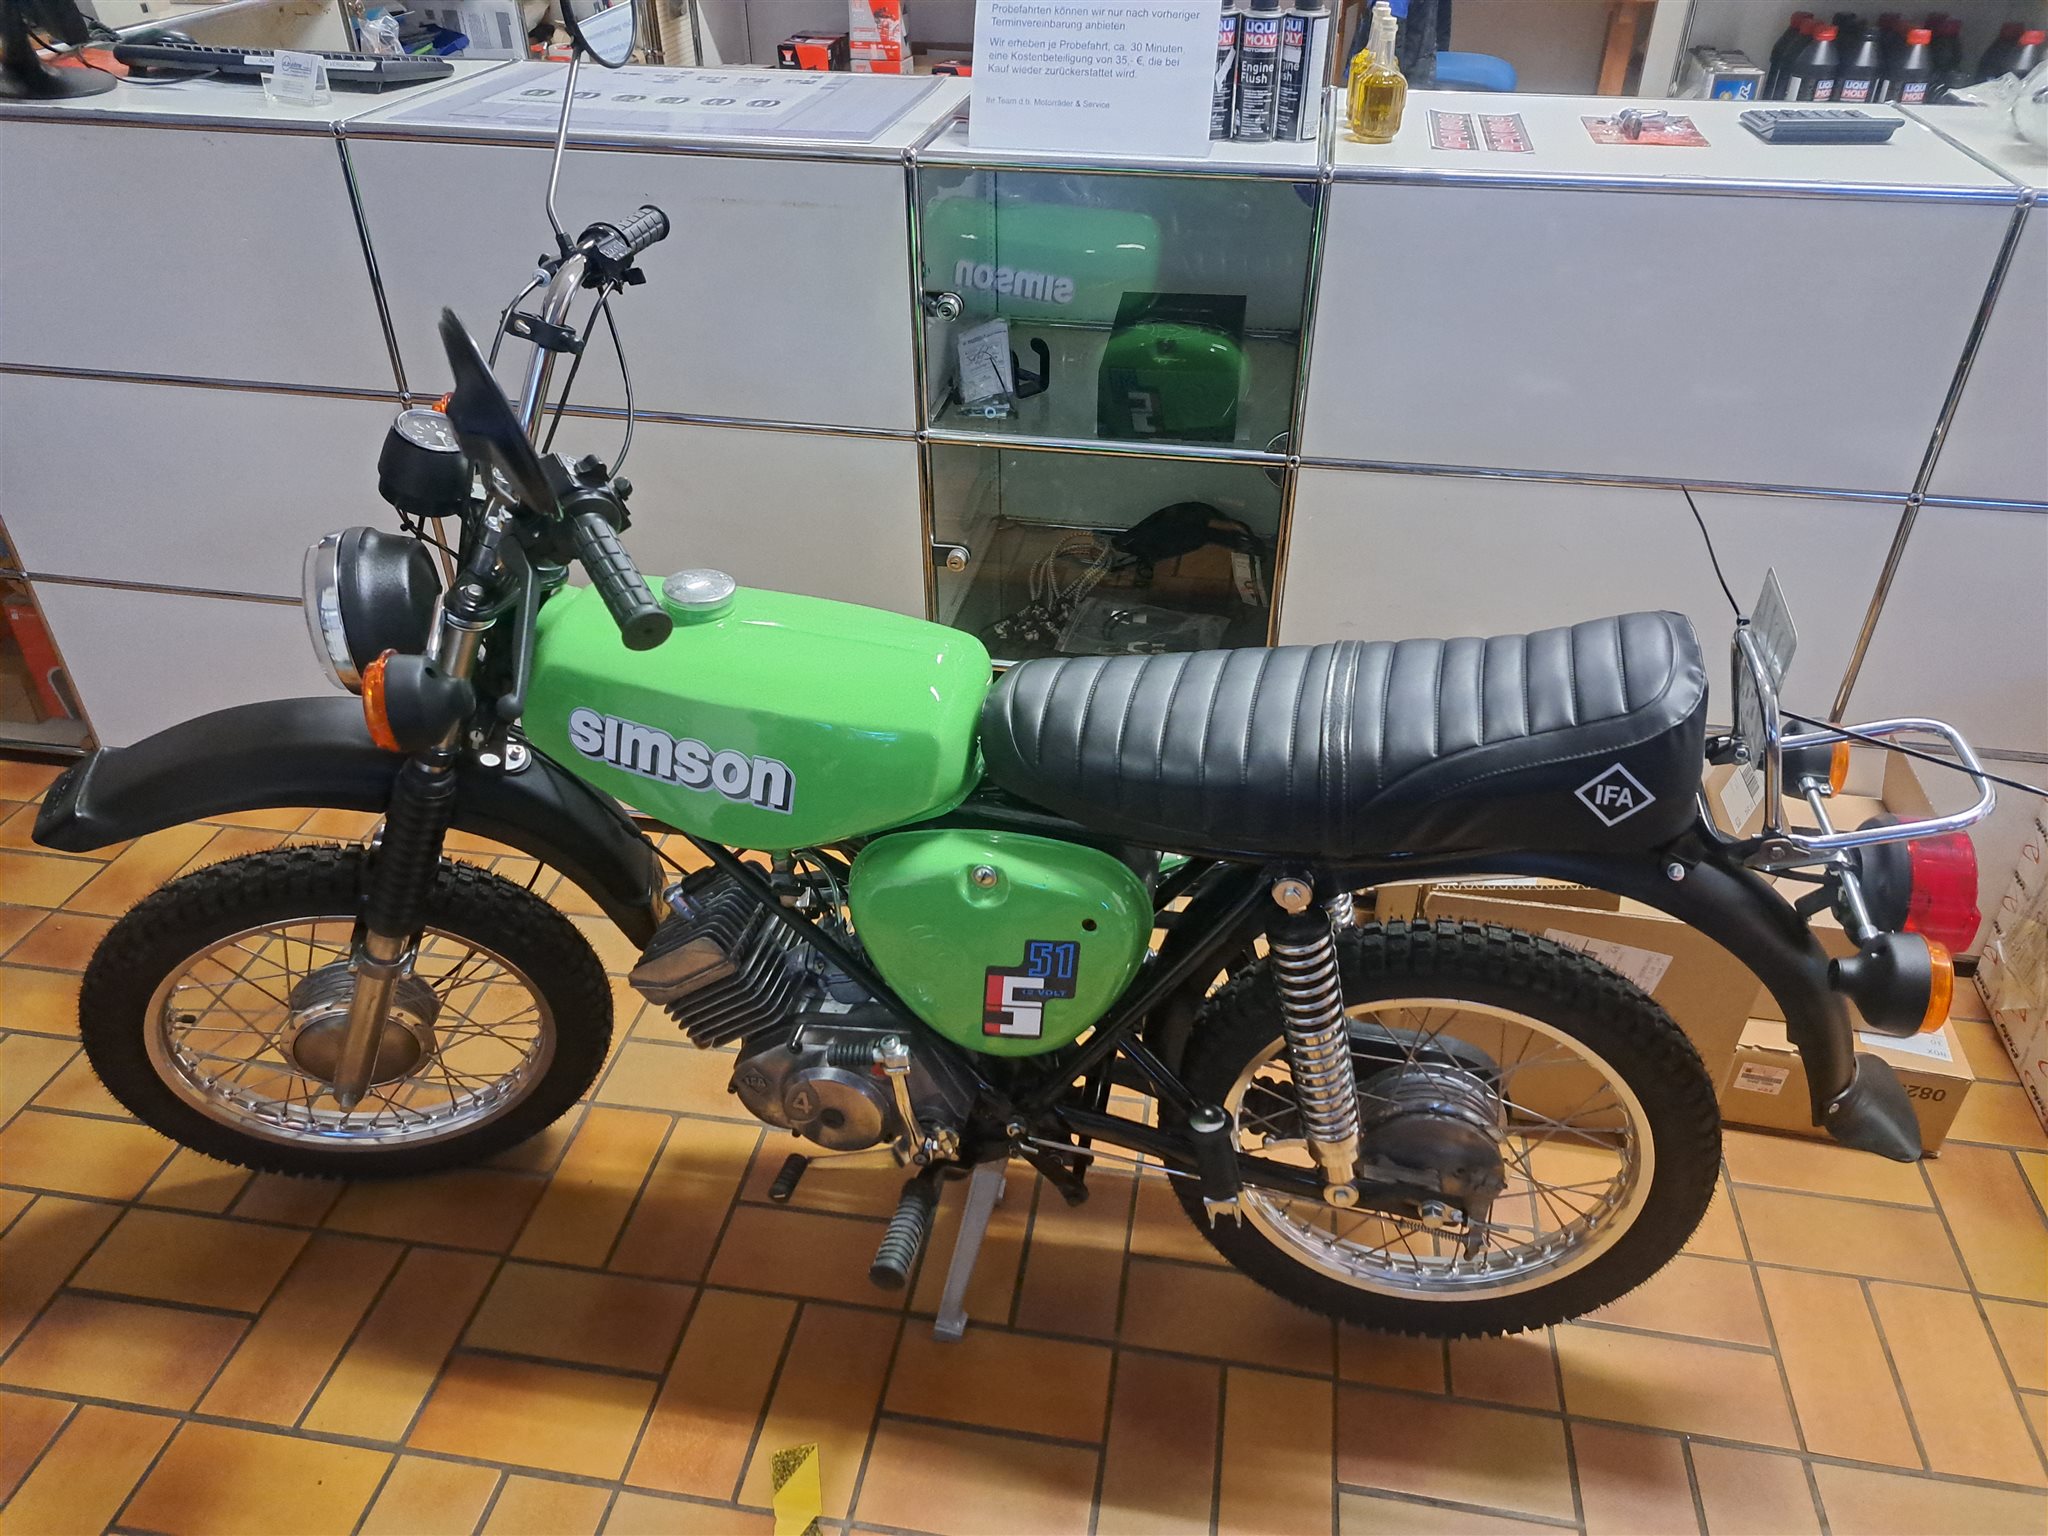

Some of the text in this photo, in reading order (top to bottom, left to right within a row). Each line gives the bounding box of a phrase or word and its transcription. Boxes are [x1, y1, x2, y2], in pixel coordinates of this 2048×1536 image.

[991, 3, 1201, 22] Probefahrten können wir nur nach vorheriger
[991, 17, 1083, 31] Terminvereinbarung
[1245, 20, 1277, 33] LIQUI
[989, 37, 1005, 47] Wir
[1007, 38, 1046, 49] erheben
[1047, 41, 1057, 51] je
[1130, 42, 1143, 52] 30
[1244, 33, 1278, 47] MOLY
[988, 51, 1009, 61] eine
[1010, 51, 1094, 66] Kostenbeteiligung
[1096, 56, 1113, 65] von
[1147, 56, 1163, 66] die
[1164, 57, 1181, 67] bei
[987, 63, 1010, 73] Kauf
[1011, 65, 1042, 75] wieder
[1044, 66, 1113, 78] zurückerstattet
[1241, 60, 1275, 75] Engine
[1240, 72, 1268, 84] Flush
[1844, 80, 1870, 90] LIQUI
[1841, 89, 1868, 98] MOLY
[997, 96, 1017, 105] Team
[1033, 98, 1074, 108] Motorräder
[1075, 100, 1082, 108] &
[1082, 101, 1111, 109] Service
[569, 706, 795, 814] simson
[1594, 784, 1634, 809] IFA
[1028, 942, 1075, 979] 51
[1038, 989, 1068, 998] VOLT
[1904, 1084, 1947, 1102] 082
